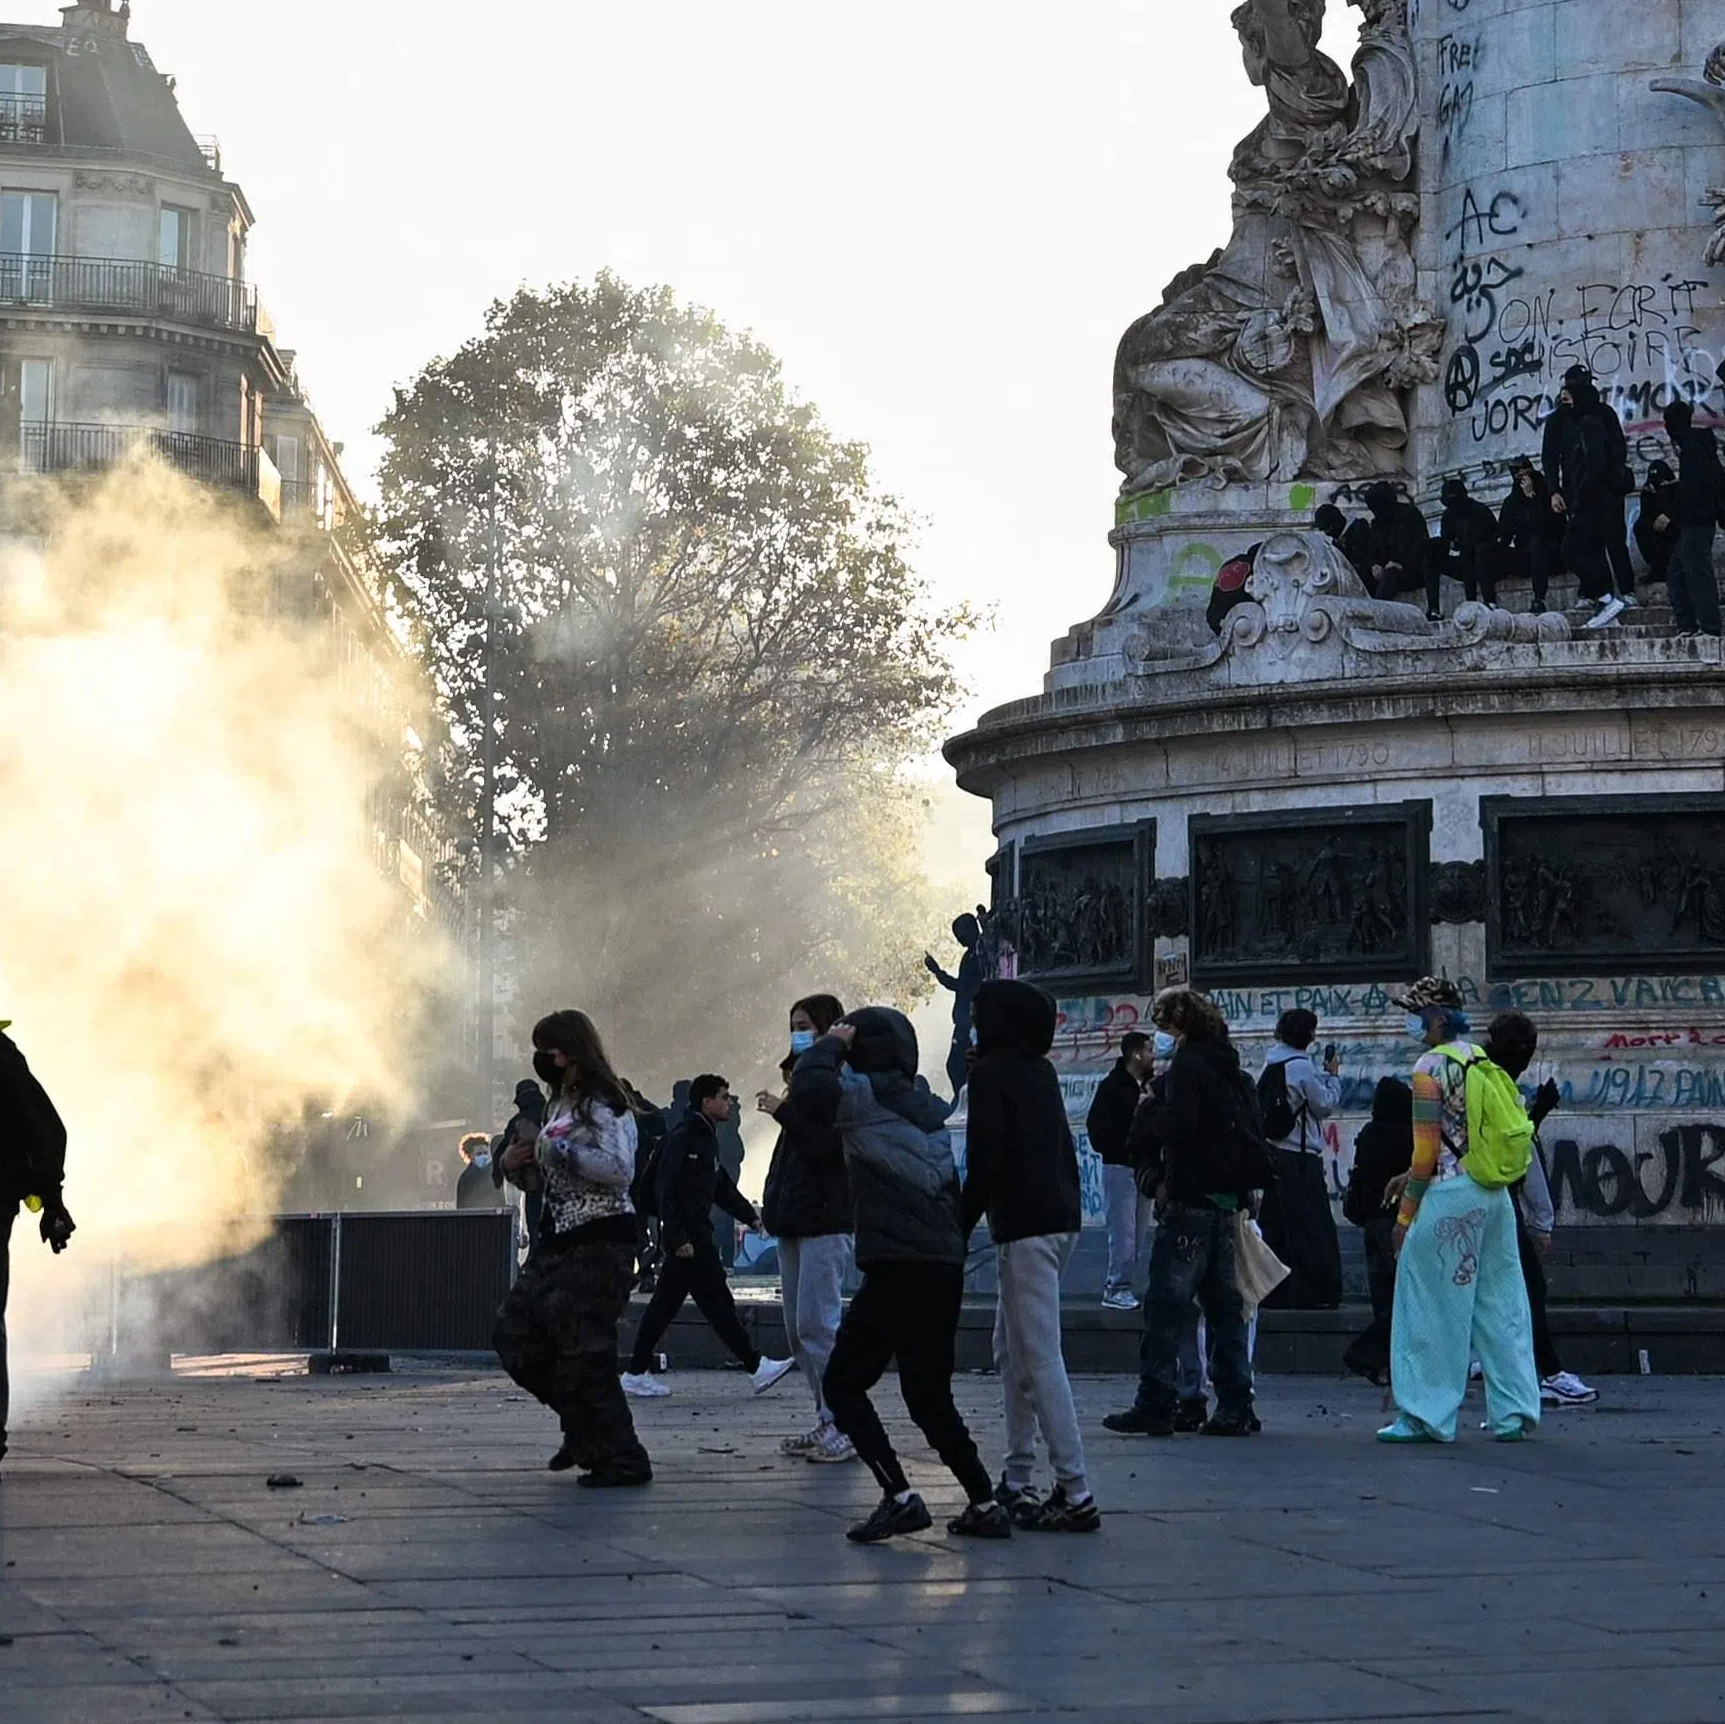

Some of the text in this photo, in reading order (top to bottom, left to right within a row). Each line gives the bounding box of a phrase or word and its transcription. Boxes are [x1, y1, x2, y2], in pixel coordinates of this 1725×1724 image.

[1336, 742, 1390, 768] 1790
[1554, 729, 1666, 757] JUILLET
[1294, 986, 1353, 1018] PAIX
